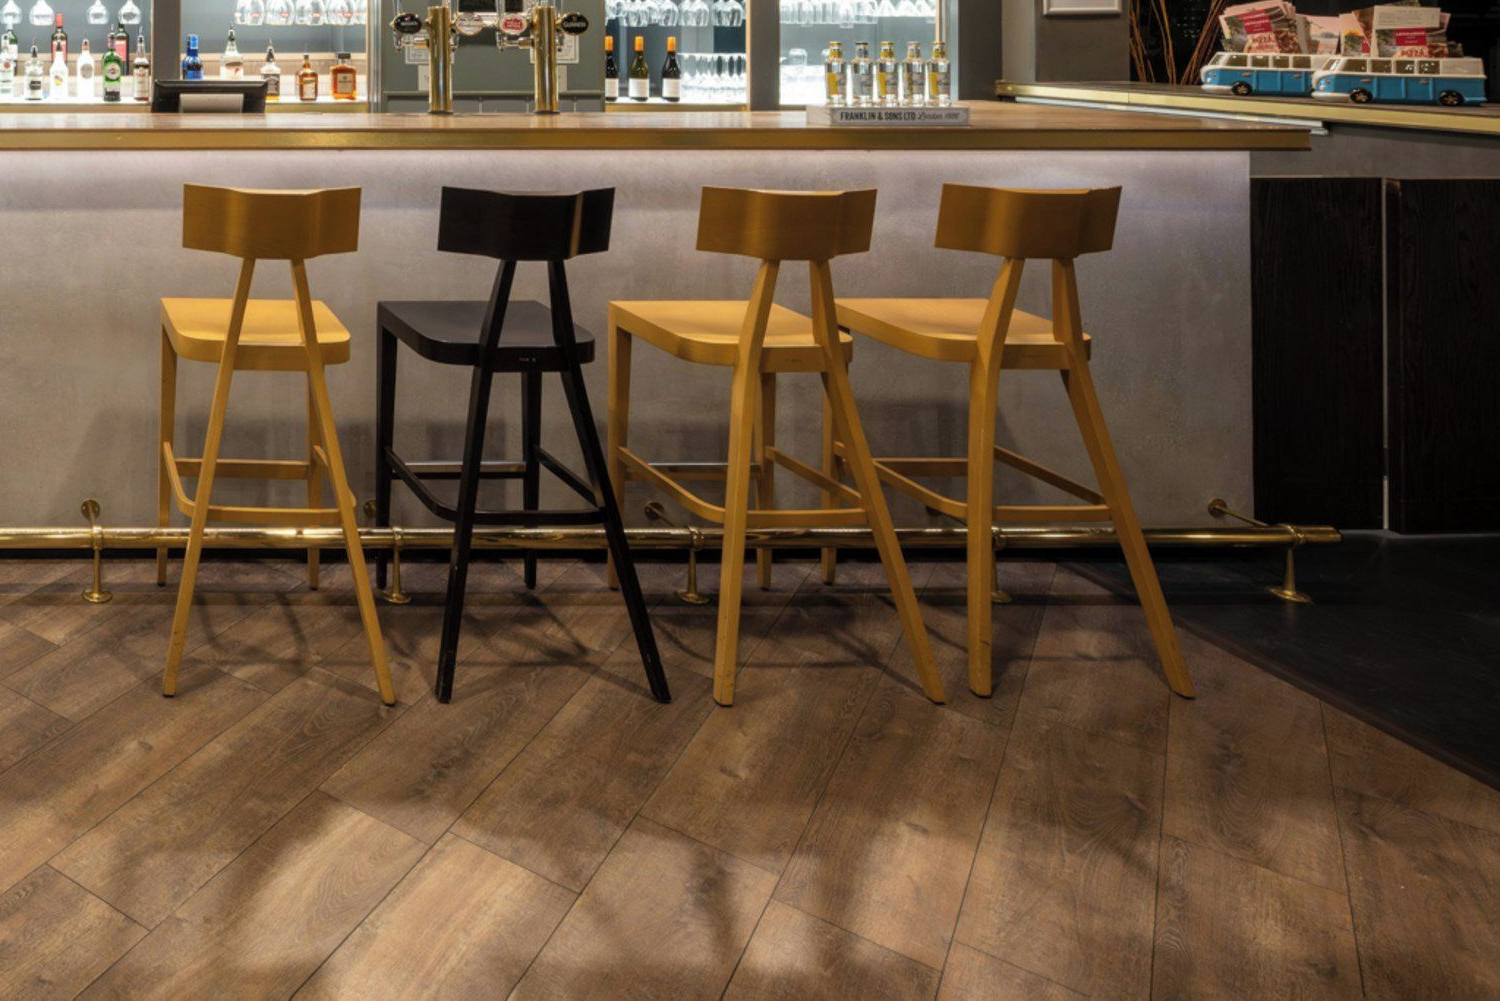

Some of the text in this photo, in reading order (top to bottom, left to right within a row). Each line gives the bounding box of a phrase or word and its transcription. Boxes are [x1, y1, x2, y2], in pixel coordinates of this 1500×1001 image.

[840, 111, 876, 121] FRANKLIN
[877, 111, 884, 121] &
[884, 111, 903, 121] SONS
[903, 111, 916, 121] LTD
[917, 111, 943, 121] London
